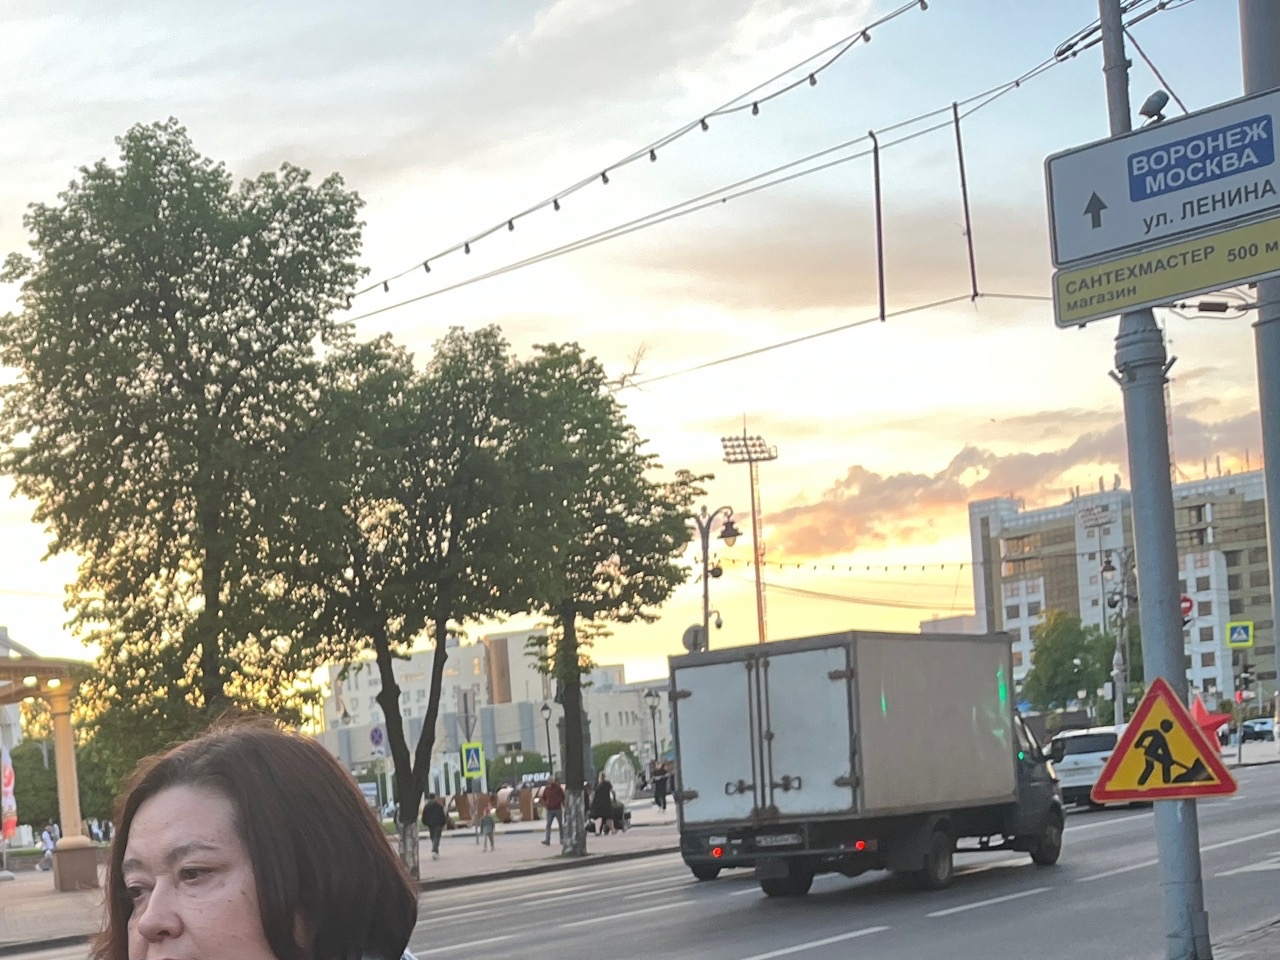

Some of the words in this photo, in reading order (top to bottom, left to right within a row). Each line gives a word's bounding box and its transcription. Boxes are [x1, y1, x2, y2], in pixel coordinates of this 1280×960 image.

[1132, 120, 1268, 175] ВОРОНЕЖ
[1145, 148, 1259, 194] МОСКВА
[1143, 212, 1174, 235] ул.
[1181, 179, 1277, 220] ЛЕНИНА
[1065, 245, 1216, 295] САНТЕХМАСТЕР
[1227, 243, 1259, 263] 500
[1067, 286, 1137, 312] магазин
